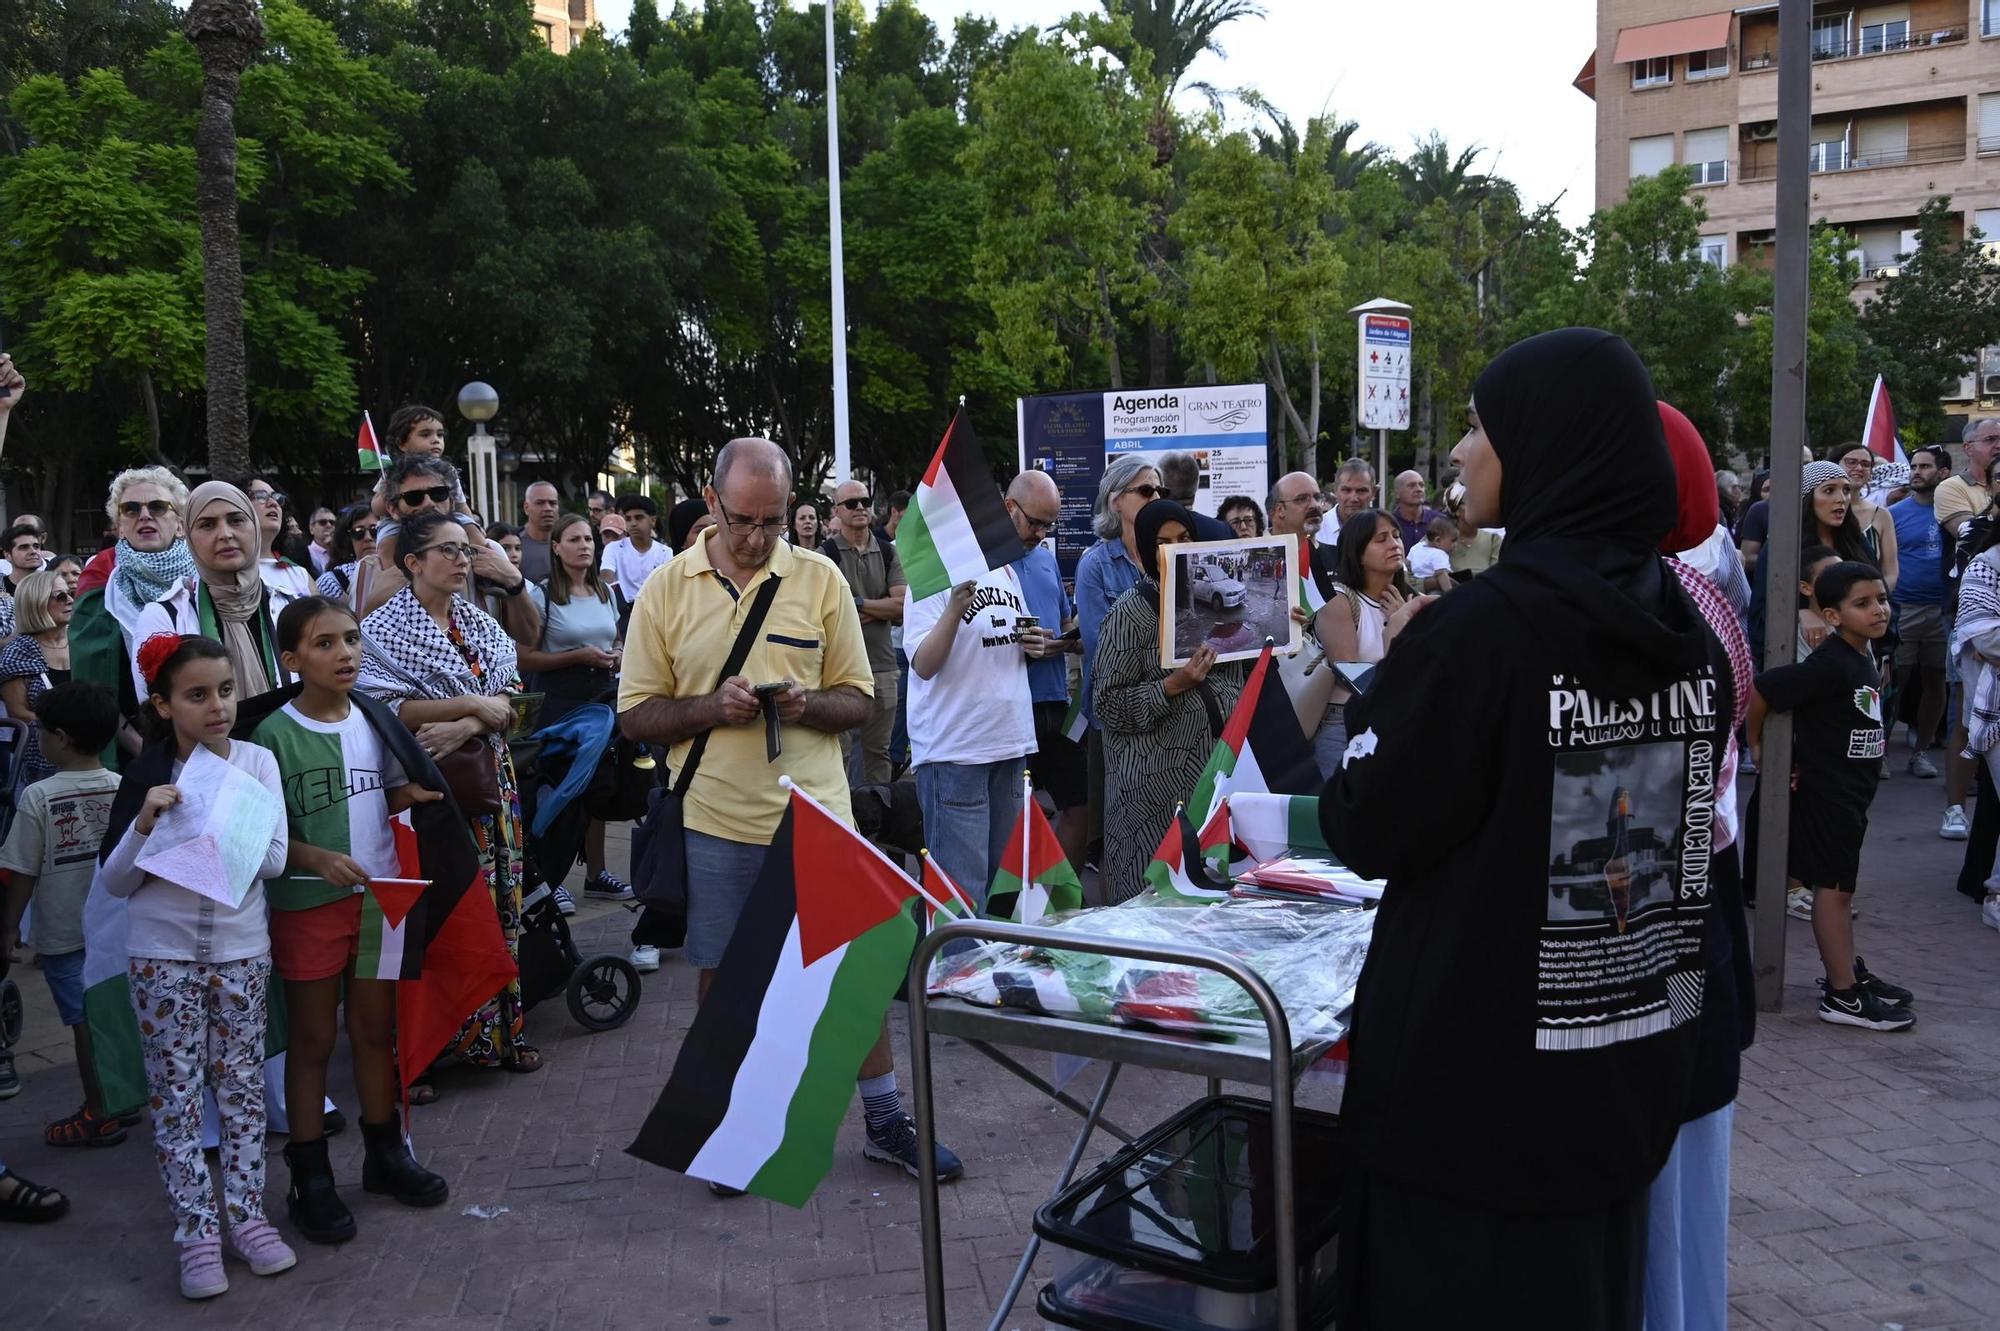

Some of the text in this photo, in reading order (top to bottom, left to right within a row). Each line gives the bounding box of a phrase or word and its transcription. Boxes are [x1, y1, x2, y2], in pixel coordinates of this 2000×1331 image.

[1113, 394, 1178, 414] Agenda
[1188, 399, 1262, 411] GRAN TEATRO
[1113, 413, 1180, 426] Programación
[1152, 425, 1178, 434] 2025
[1114, 440, 1143, 449] ABRIL
[1849, 731, 1866, 756] FREE
[1681, 739, 1714, 900] GENOCIDE
[1539, 950, 1565, 959] kaum
[1538, 959, 1586, 969] kesusahan
[1538, 970, 1574, 980] dengan
[1538, 979, 1598, 991] persaudaraan
